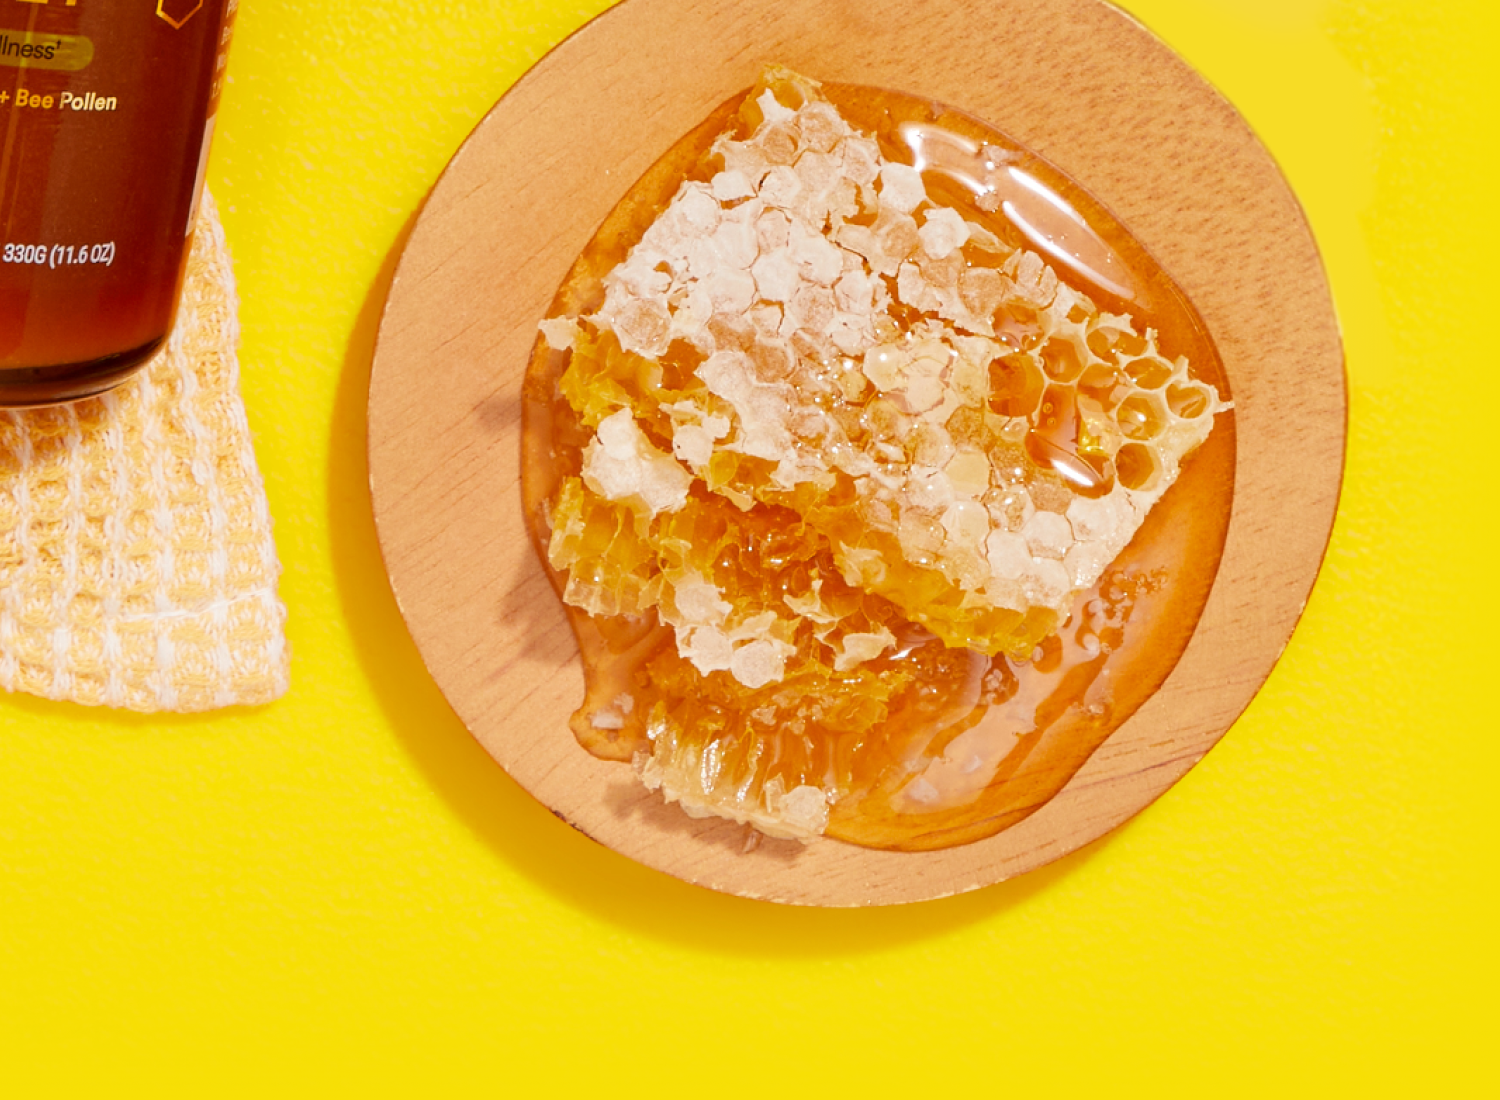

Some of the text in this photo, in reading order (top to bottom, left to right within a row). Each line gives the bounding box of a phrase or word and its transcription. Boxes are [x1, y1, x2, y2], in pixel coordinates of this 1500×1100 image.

[15, 88, 54, 109] Bee
[59, 91, 117, 111] Pollen
[3, 243, 47, 264] 330G
[49, 243, 88, 269] (11.6
[89, 241, 116, 266] OZ)
